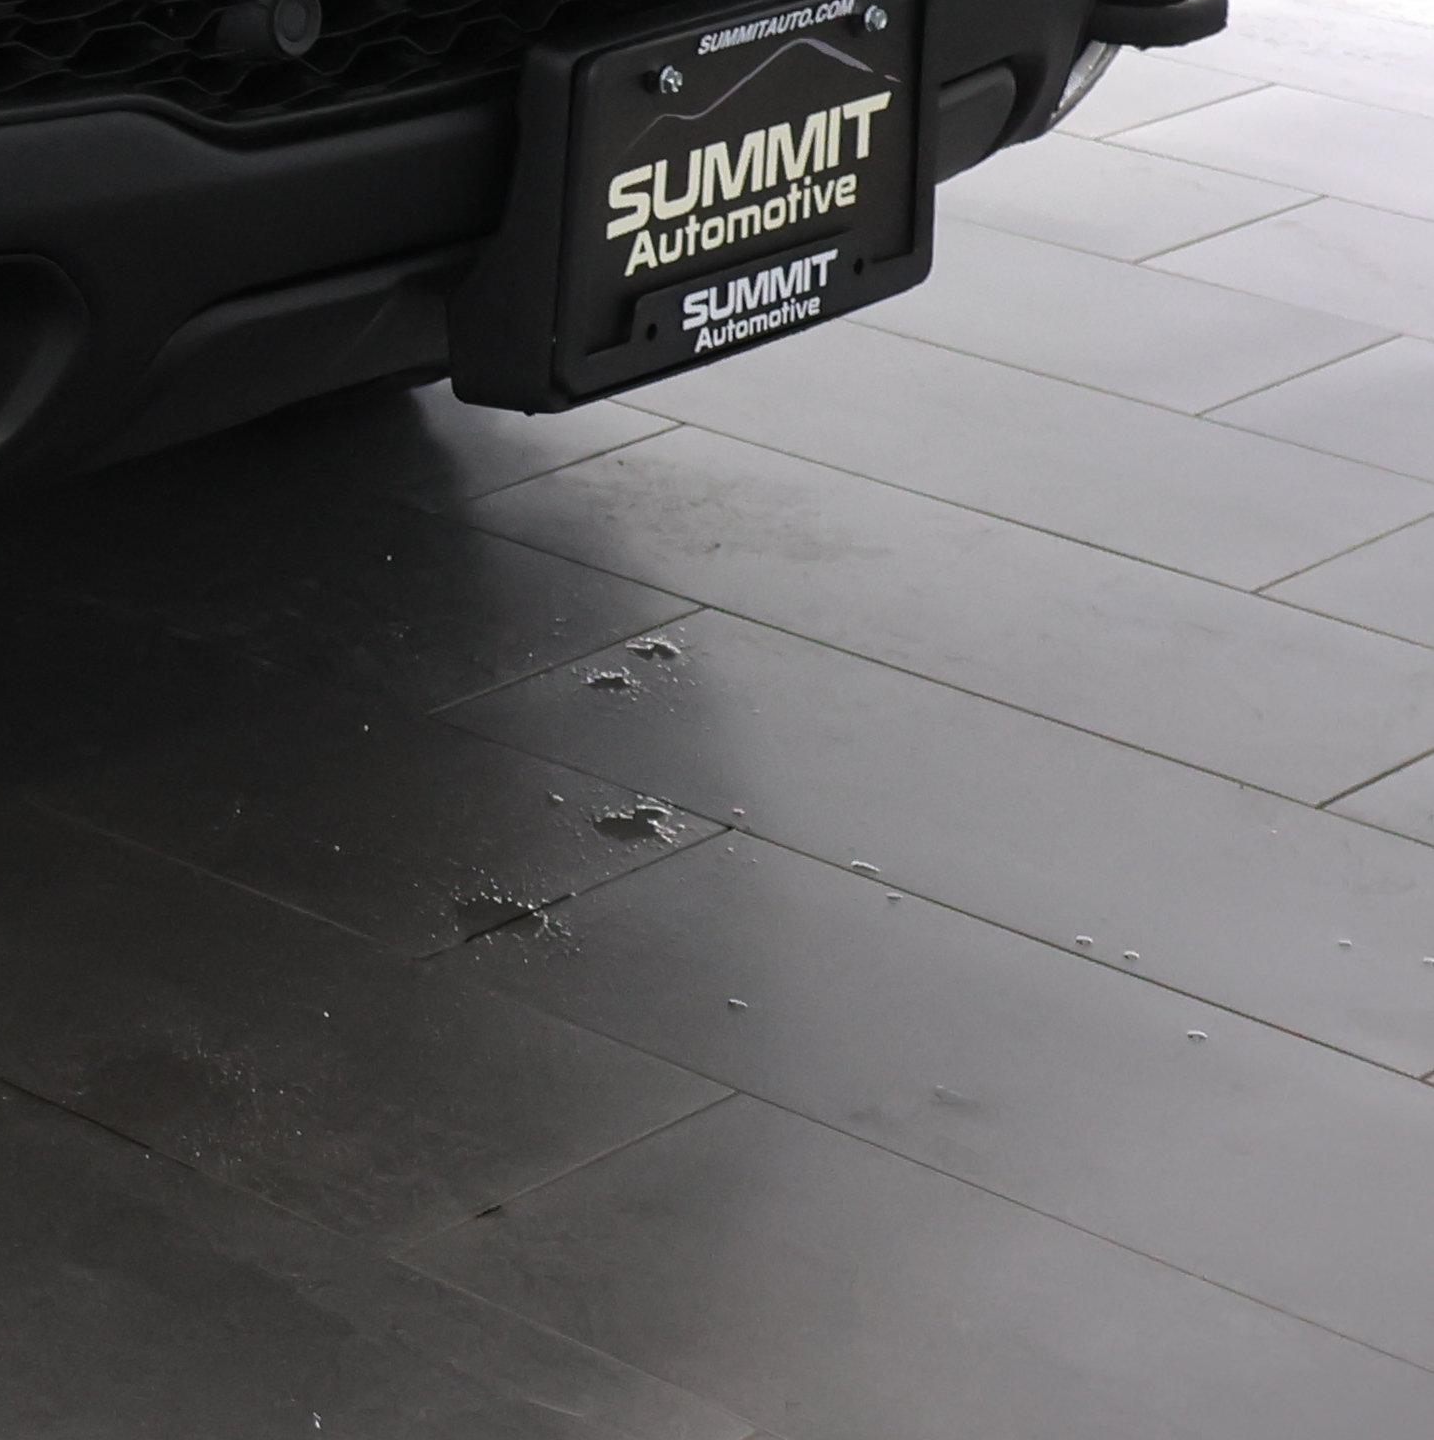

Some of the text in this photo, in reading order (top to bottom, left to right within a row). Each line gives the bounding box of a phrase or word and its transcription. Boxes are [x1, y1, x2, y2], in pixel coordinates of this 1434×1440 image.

[606, 90, 892, 240] SUMMIT
[624, 173, 858, 277] Automotive
[682, 249, 839, 331] SUMMIT
[695, 295, 821, 353] Automotive
